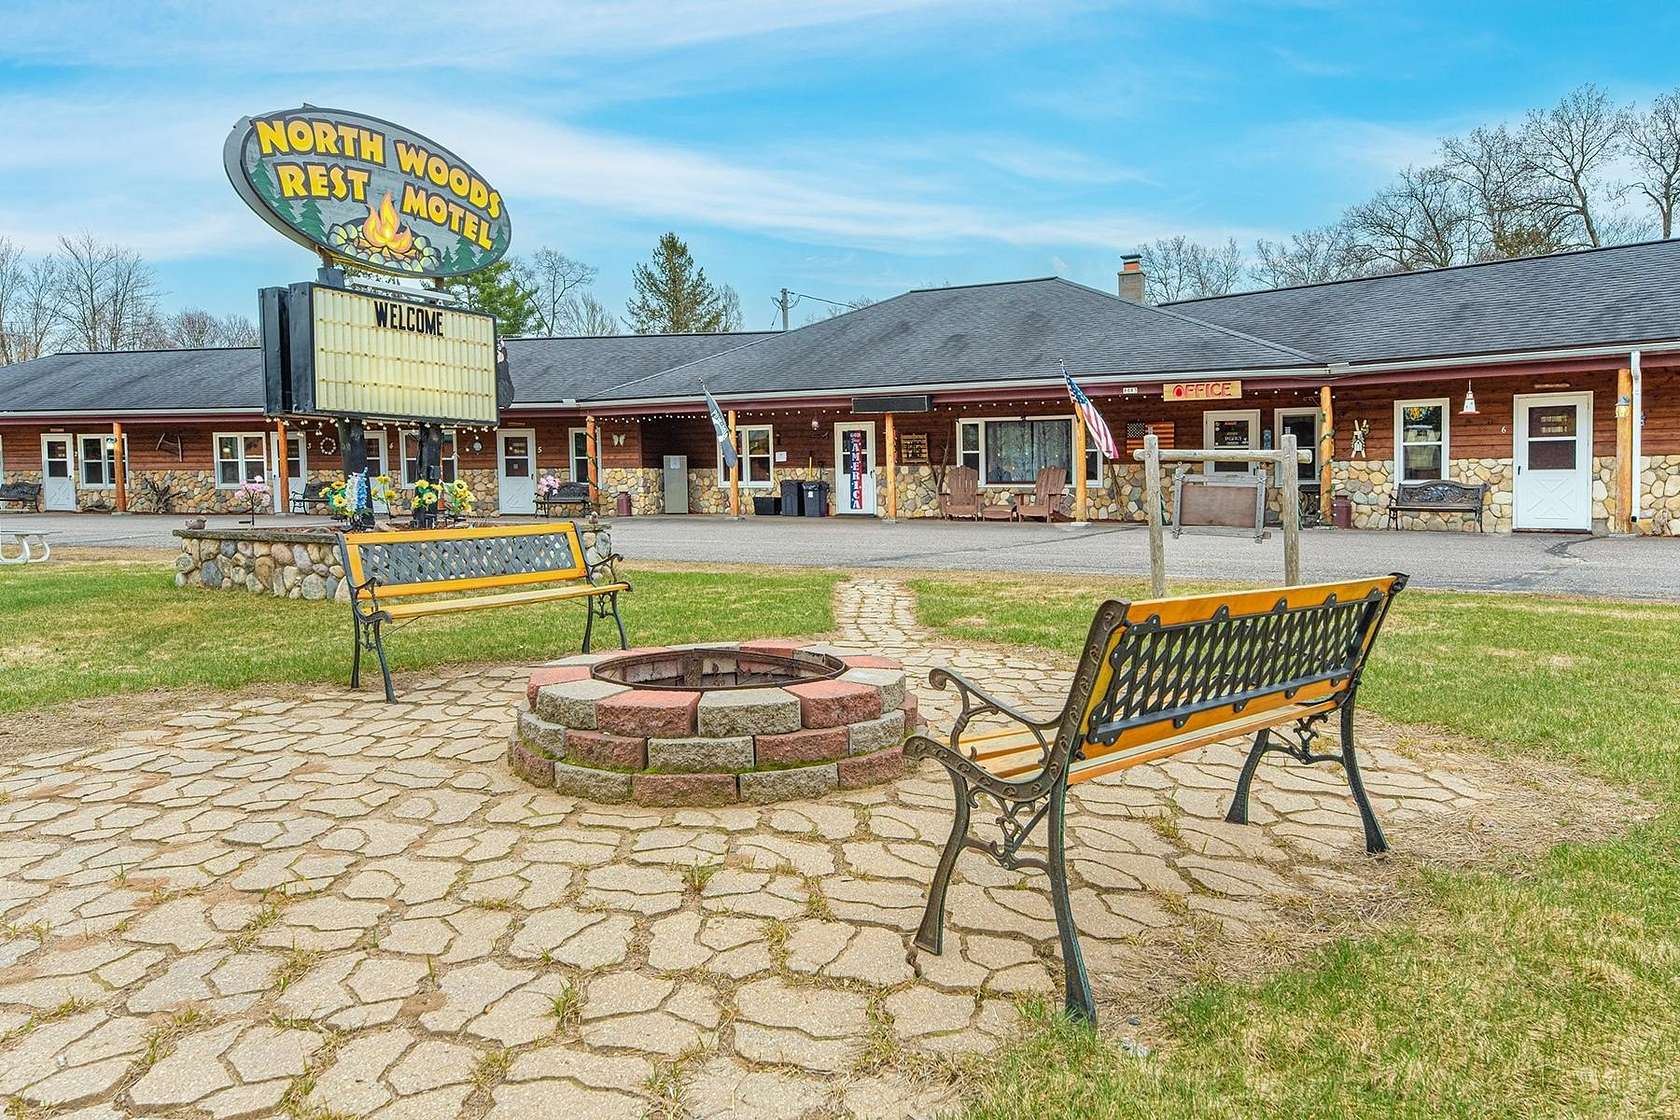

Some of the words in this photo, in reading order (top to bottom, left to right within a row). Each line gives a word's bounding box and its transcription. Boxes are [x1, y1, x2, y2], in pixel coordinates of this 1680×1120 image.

[255, 119, 385, 166] NORTH
[395, 141, 501, 219] WOODS
[275, 163, 370, 201] REST
[402, 184, 494, 251] MOTEL
[374, 300, 443, 336] WELCOME
[1172, 382, 1232, 398] OFFICE
[1501, 425, 1507, 433] 6
[852, 443, 861, 509] AMERICA
